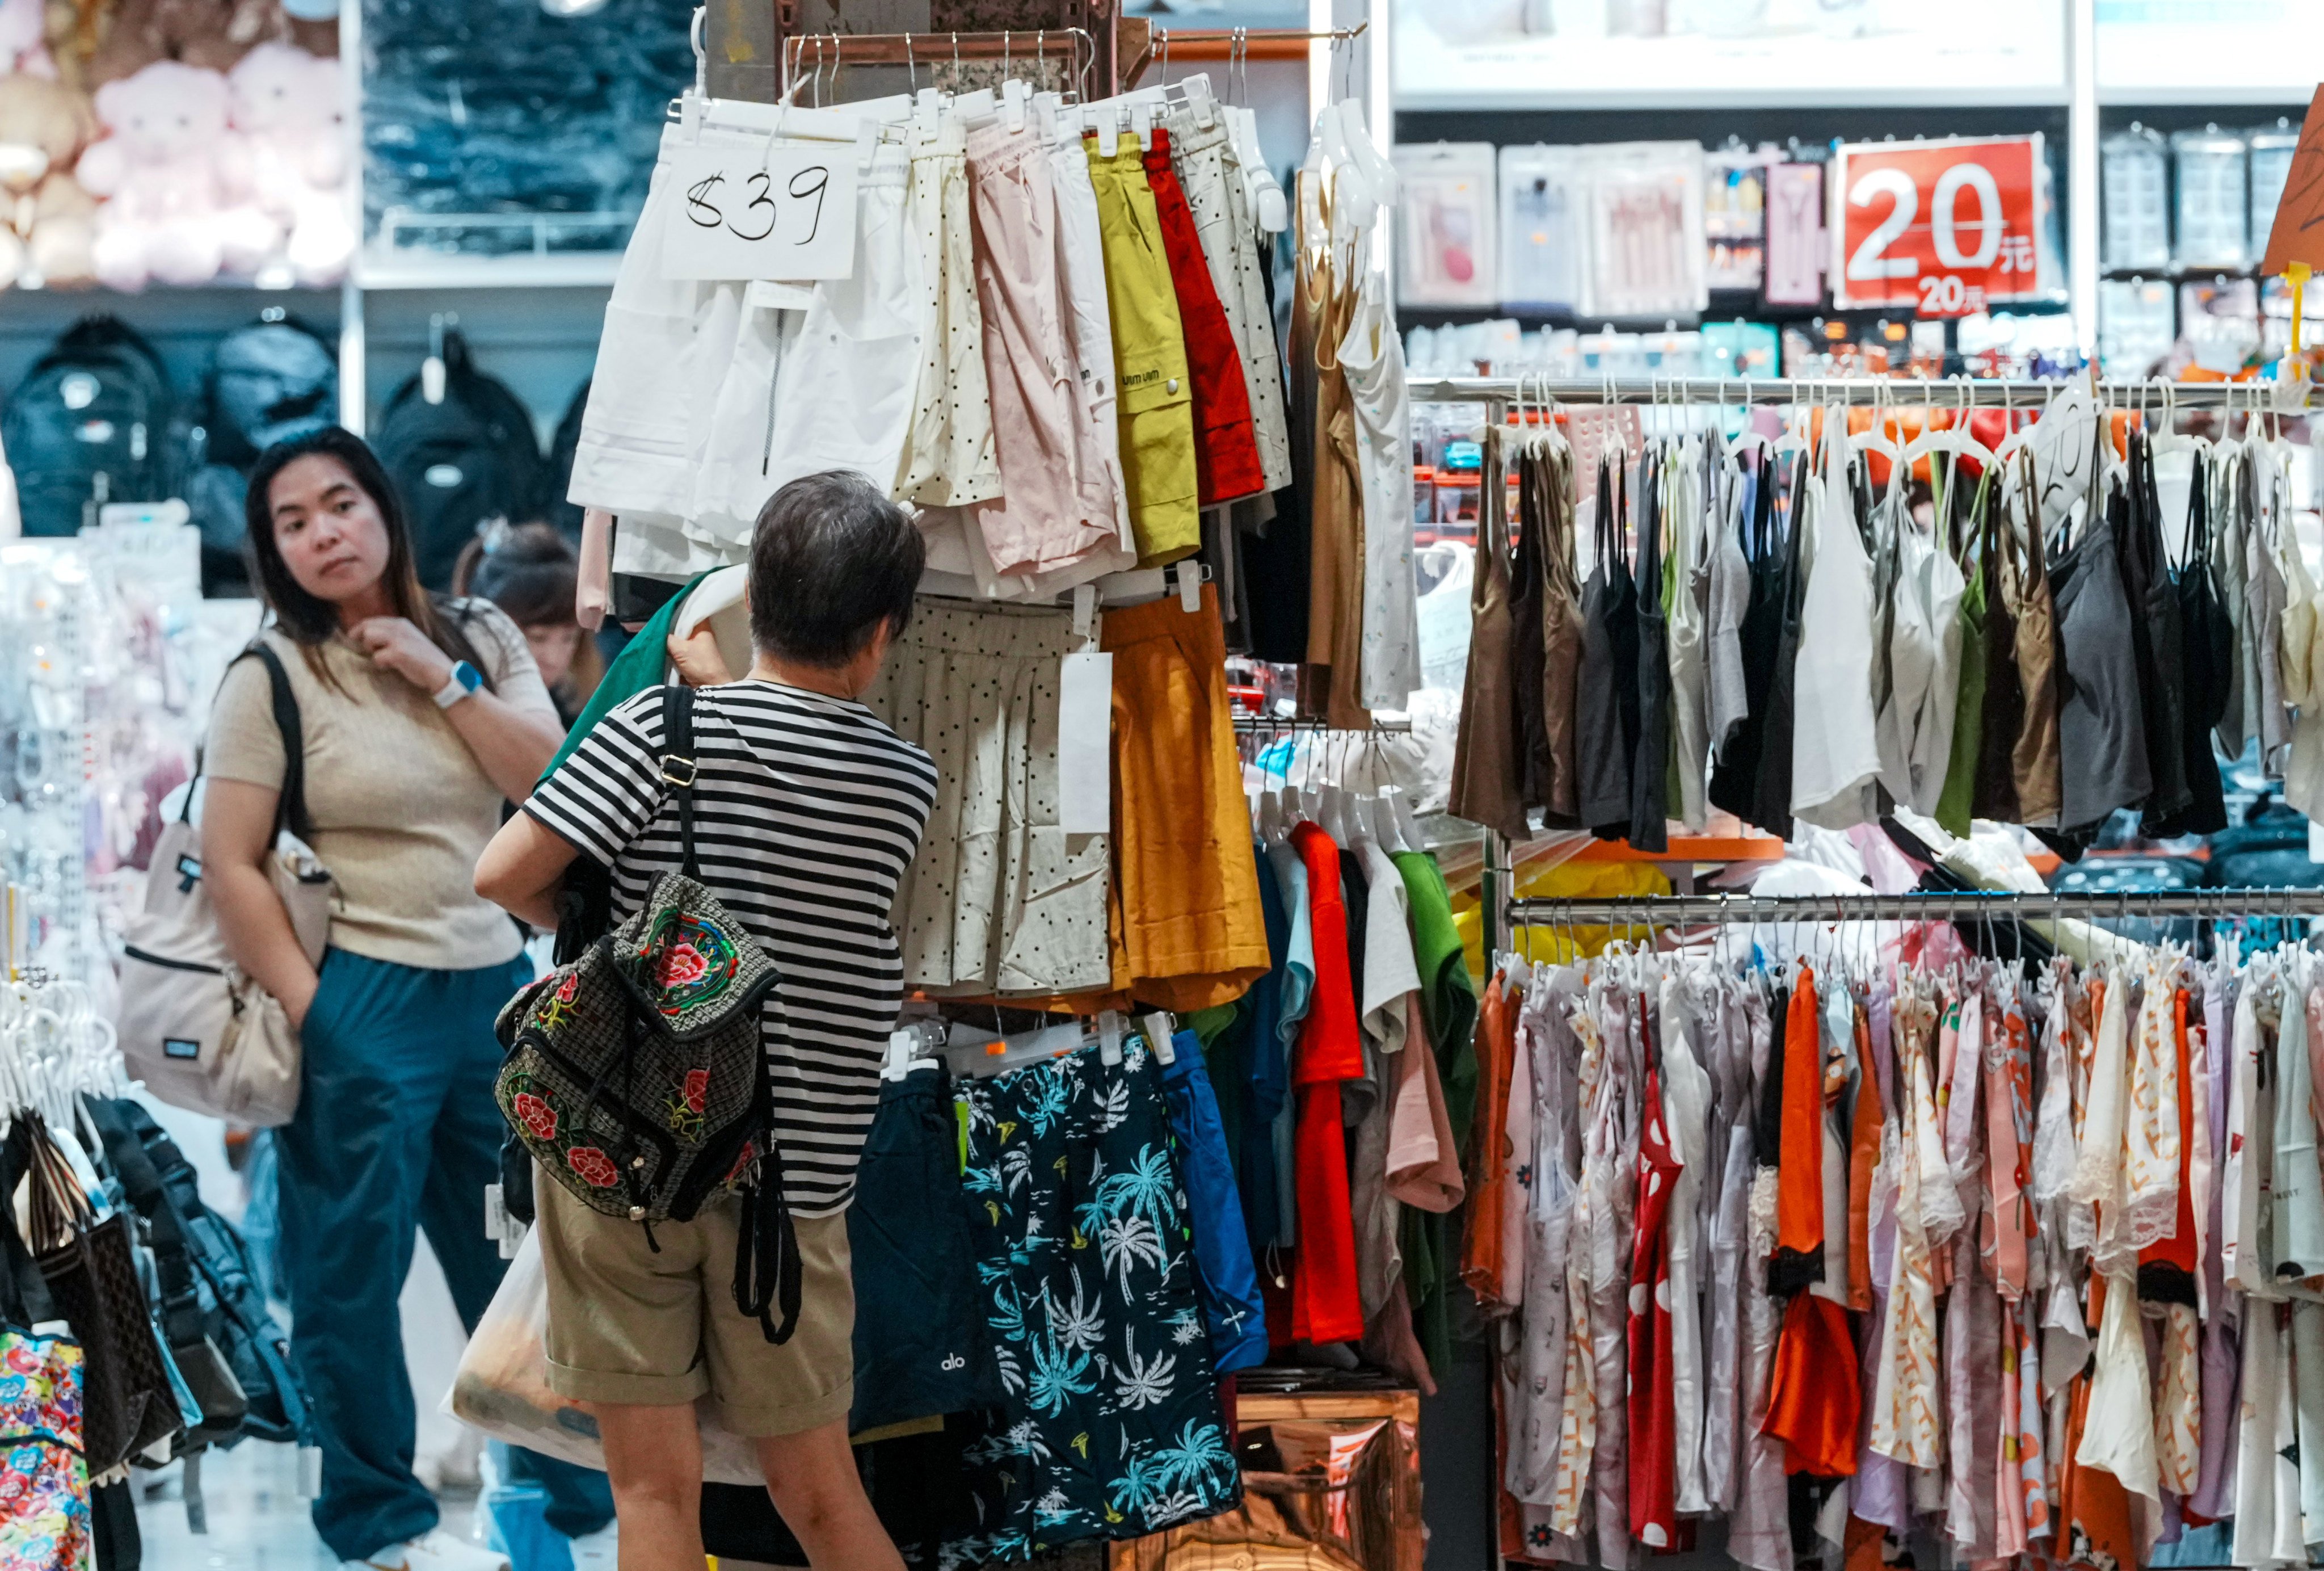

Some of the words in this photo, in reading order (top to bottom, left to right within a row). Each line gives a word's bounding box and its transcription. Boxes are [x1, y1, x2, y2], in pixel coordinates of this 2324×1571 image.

[686, 166, 828, 245] $39
[1847, 163, 2035, 280] 20元
[941, 1352, 965, 1371] alo
